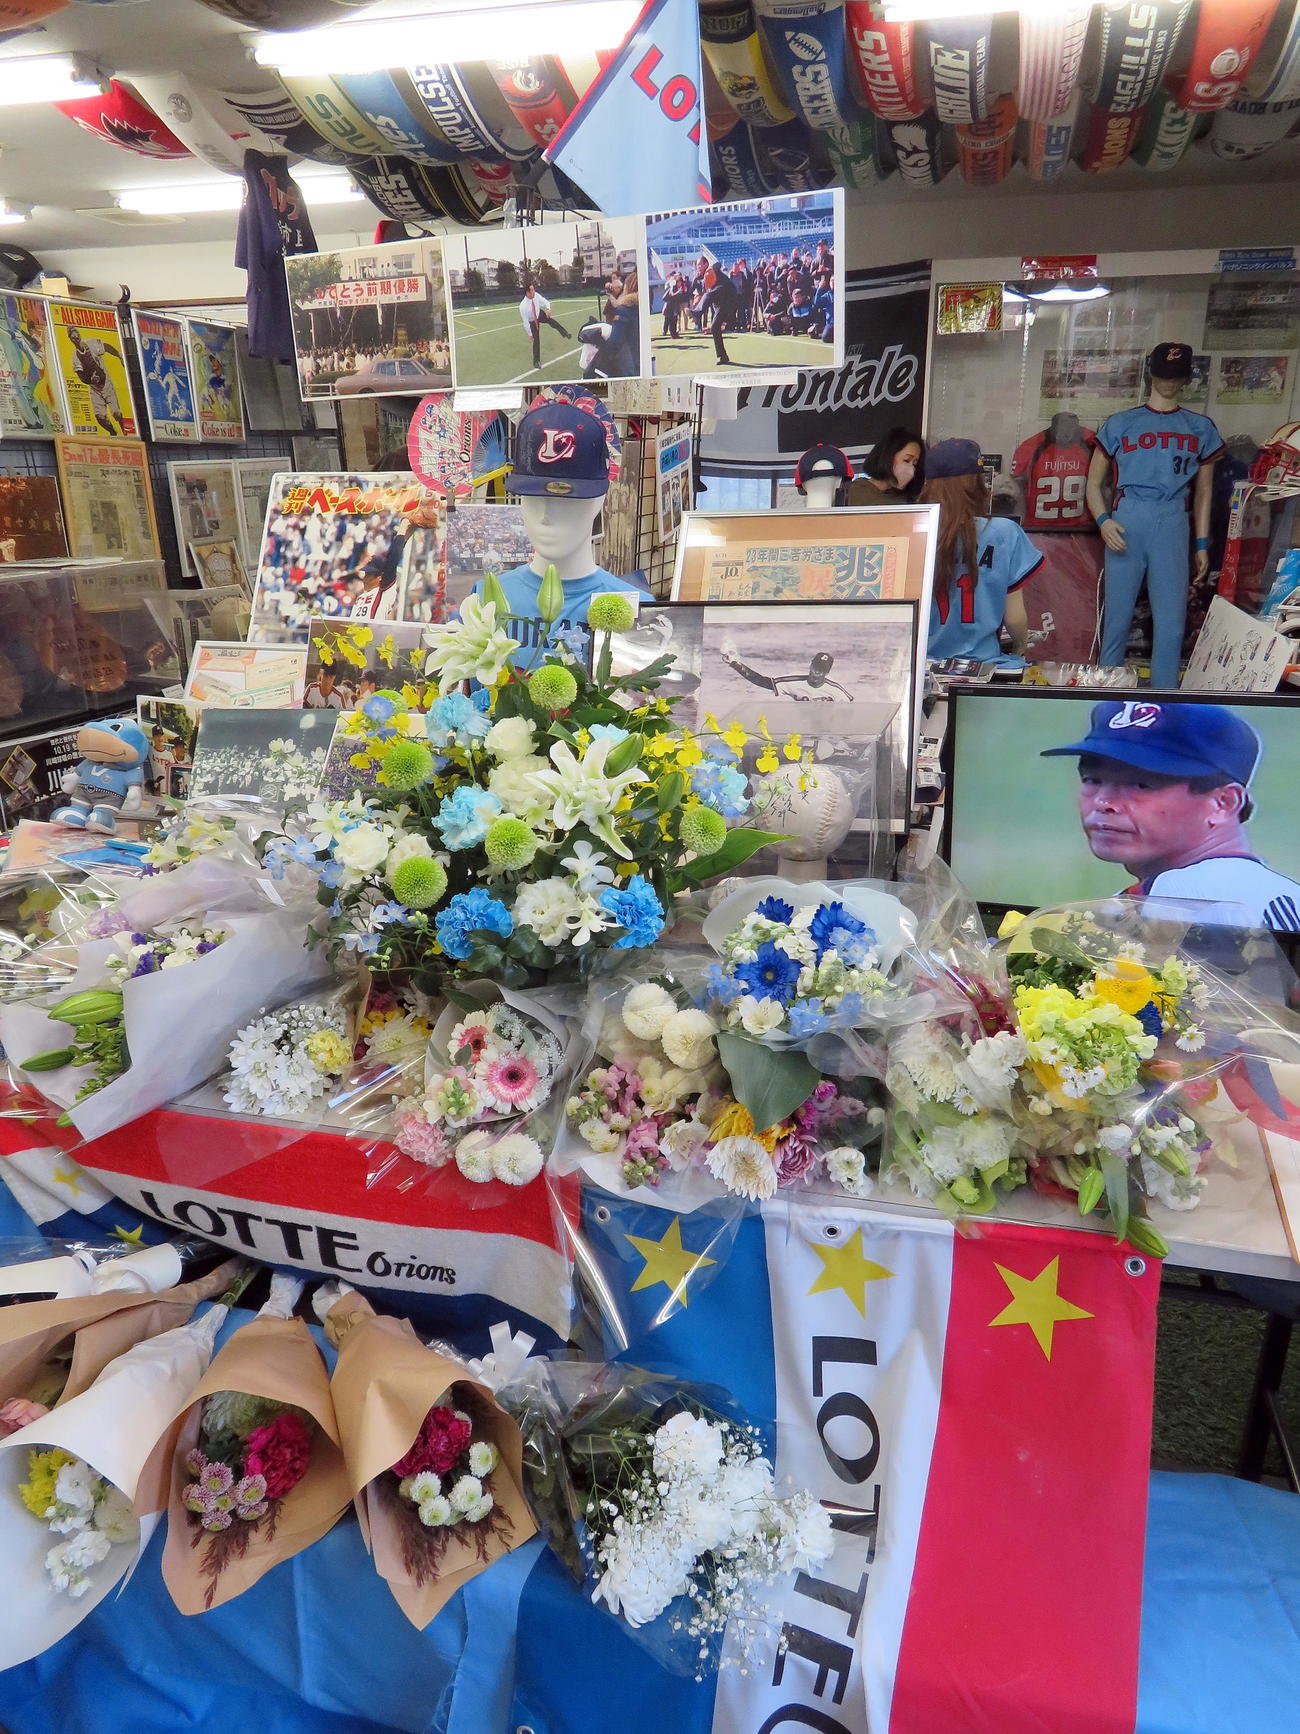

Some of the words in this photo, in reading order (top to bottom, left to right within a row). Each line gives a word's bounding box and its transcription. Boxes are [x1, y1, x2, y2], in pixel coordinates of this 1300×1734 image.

[976, 36, 986, 66] TEAM
[1154, 30, 1168, 53] 1983
[164, 423, 183, 437] Coke
[201, 421, 219, 437] Coke
[220, 423, 228, 437] is
[459, 418, 473, 463] Orions
[1044, 459, 1081, 471] FUJITSU
[1172, 455, 1191, 476] 31
[306, 486, 421, 515] ベースボール
[1034, 475, 1088, 519] 29
[356, 606, 368, 617] 29
[53, 743, 71, 755] 10.19
[140, 1189, 364, 1274] LOTTE
[366, 1253, 457, 1286] Orions
[771, 1335, 882, 1706] LOTTE
